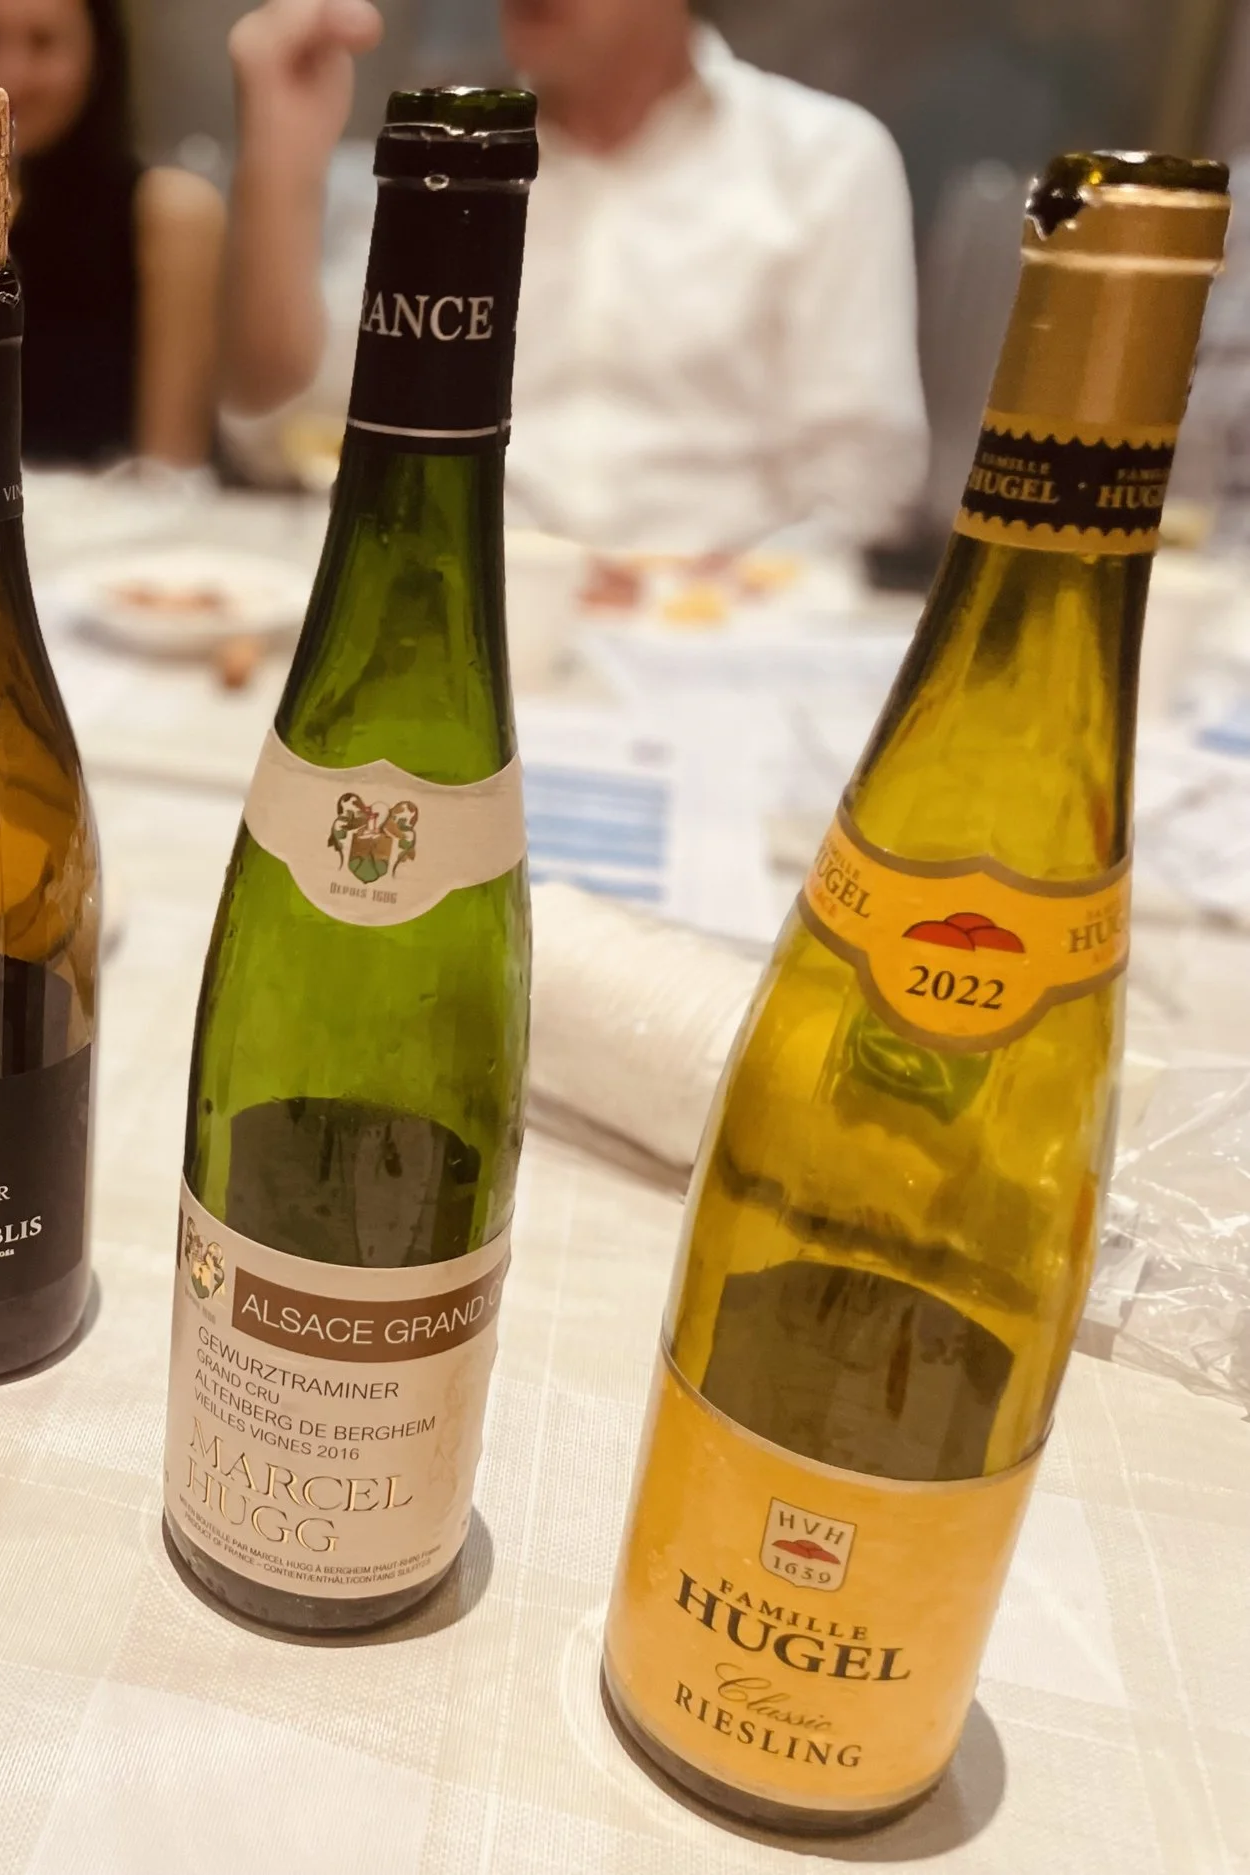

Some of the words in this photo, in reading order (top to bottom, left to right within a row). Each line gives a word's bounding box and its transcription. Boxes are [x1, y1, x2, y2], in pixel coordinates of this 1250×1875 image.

[906, 965, 1006, 1010] 2022
[241, 1294, 375, 1345] ALSACE
[384, 1295, 485, 1345] GRAND
[196, 1348, 241, 1388] GRAND
[245, 1380, 280, 1405] CRU
[198, 1325, 400, 1400] GEWURZTRAMINER
[194, 1386, 246, 1433] VIEILLES
[250, 1424, 312, 1455] VIGNES
[317, 1444, 361, 1461] 2016
[195, 1368, 293, 1431] ALTENBERG
[299, 1420, 327, 1440] DE
[334, 1415, 437, 1442] BERGHEIM
[189, 1416, 415, 1513] MARCEL
[186, 1455, 341, 1553] HUGG
[777, 1510, 845, 1547] HVH
[212, 1536, 223, 1548] OF
[224, 1545, 255, 1566] FRANCE
[232, 1538, 249, 1552] PAR
[249, 1547, 285, 1566] MARCEL
[285, 1560, 314, 1573] HUGG
[323, 1565, 372, 1576] BERGHEIM
[772, 1555, 832, 1585] 1639
[673, 1568, 912, 1682] HUGEL
[718, 1576, 869, 1640] FAMILLE
[674, 1680, 863, 1769] RIESLING
[714, 1661, 833, 1732] Classic
